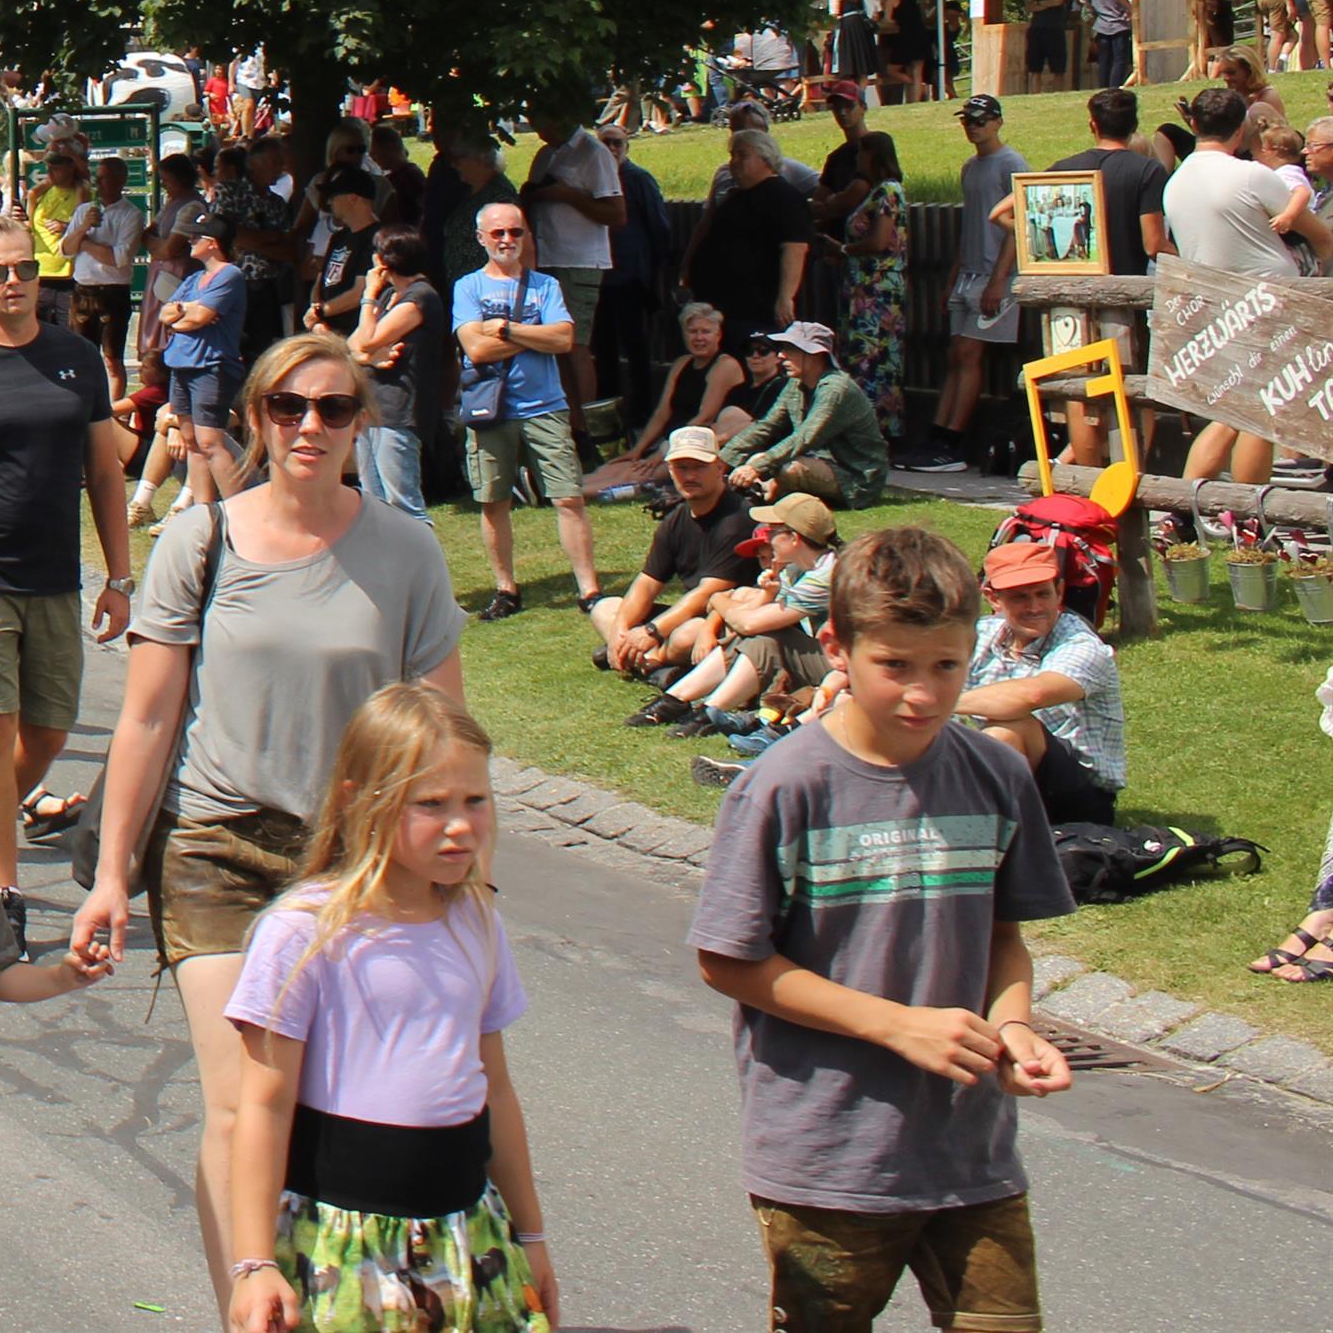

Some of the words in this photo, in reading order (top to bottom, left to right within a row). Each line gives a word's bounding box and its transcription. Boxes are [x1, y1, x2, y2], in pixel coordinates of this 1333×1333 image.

[1165, 294, 1183, 314] Der
[1176, 294, 1206, 327] CHOR
[1164, 281, 1276, 388] HERZWÄRTS
[1247, 350, 1263, 369] dir
[1268, 324, 1299, 353] einen
[858, 828, 941, 847] ORIGINAL
